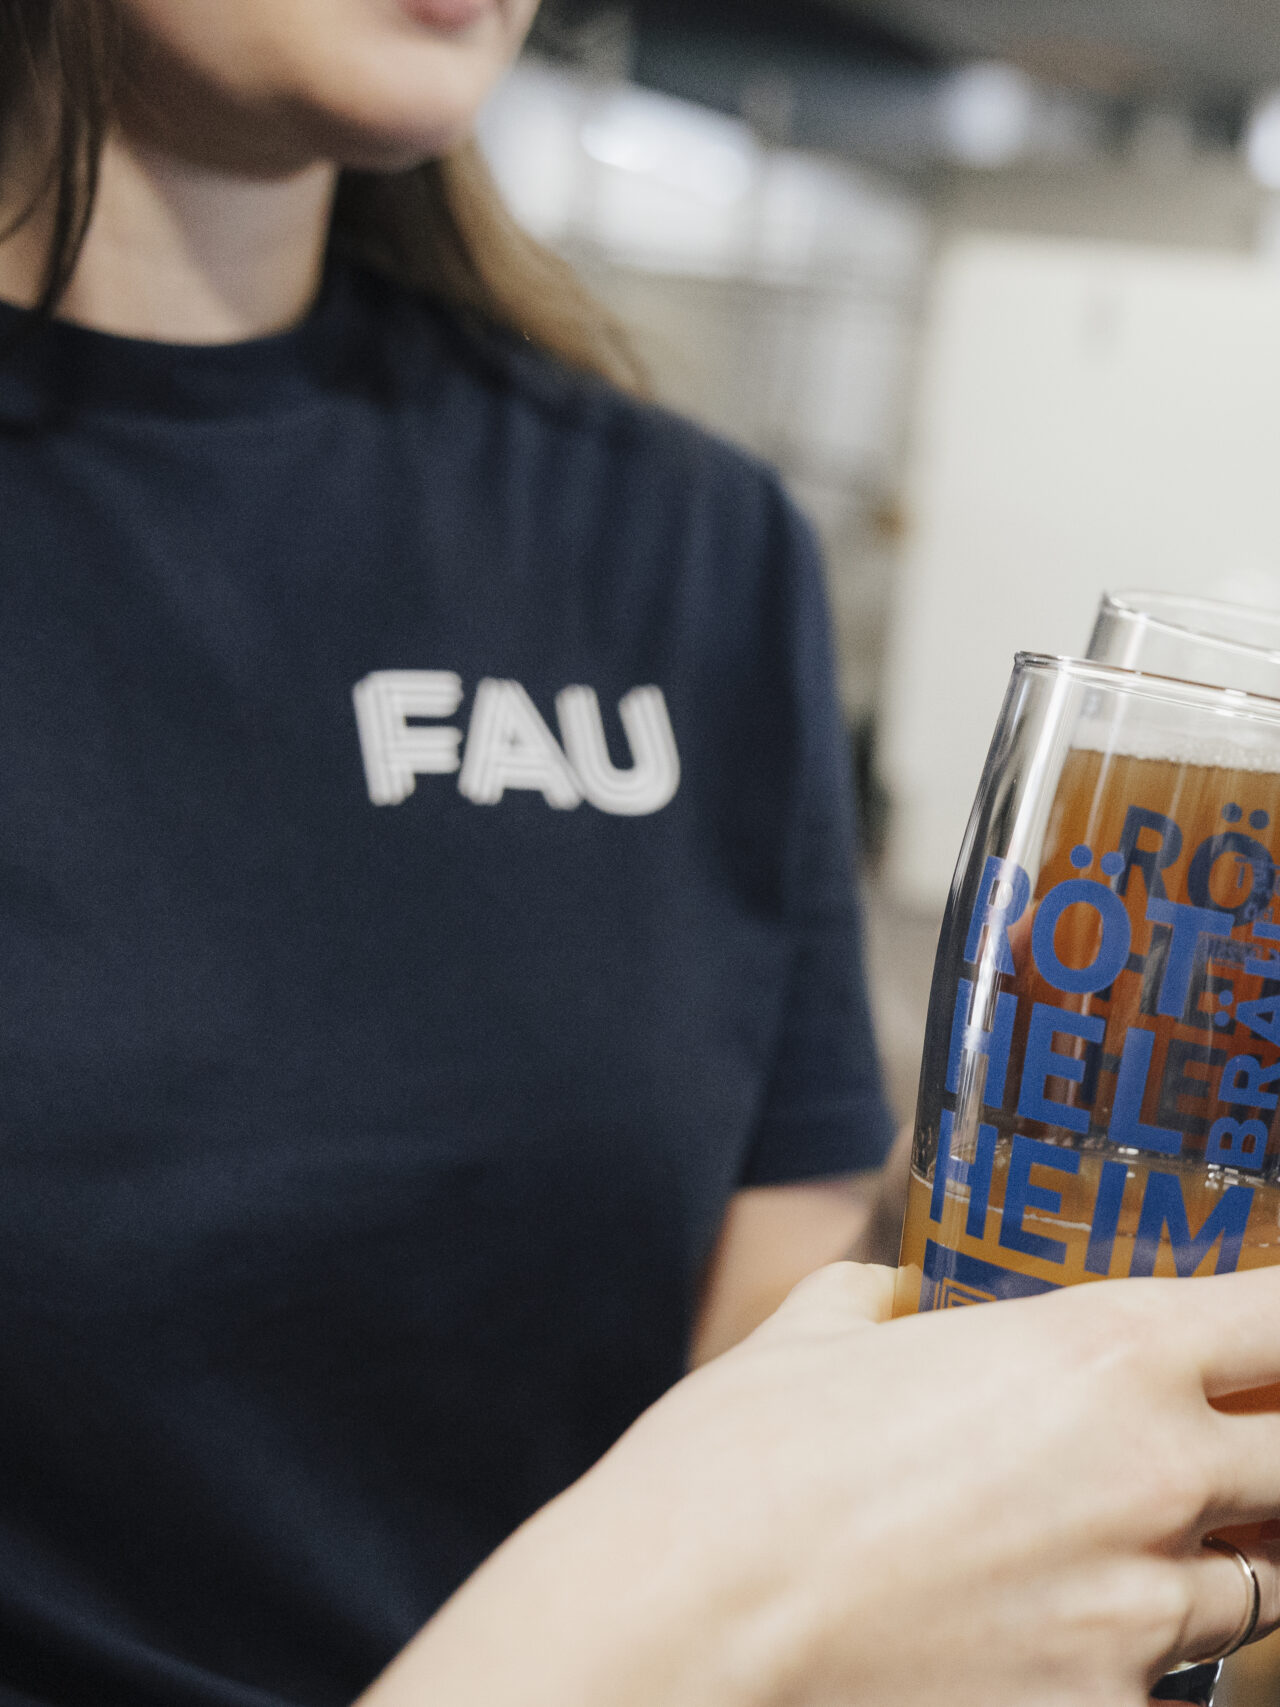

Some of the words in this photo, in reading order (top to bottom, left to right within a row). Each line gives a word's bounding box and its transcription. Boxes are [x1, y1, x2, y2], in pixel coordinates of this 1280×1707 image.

[353, 669, 681, 816] FAU
[963, 844, 1234, 1018] RÖT
[945, 977, 1183, 1154] HEL
[929, 1108, 1255, 1278] HEIM
